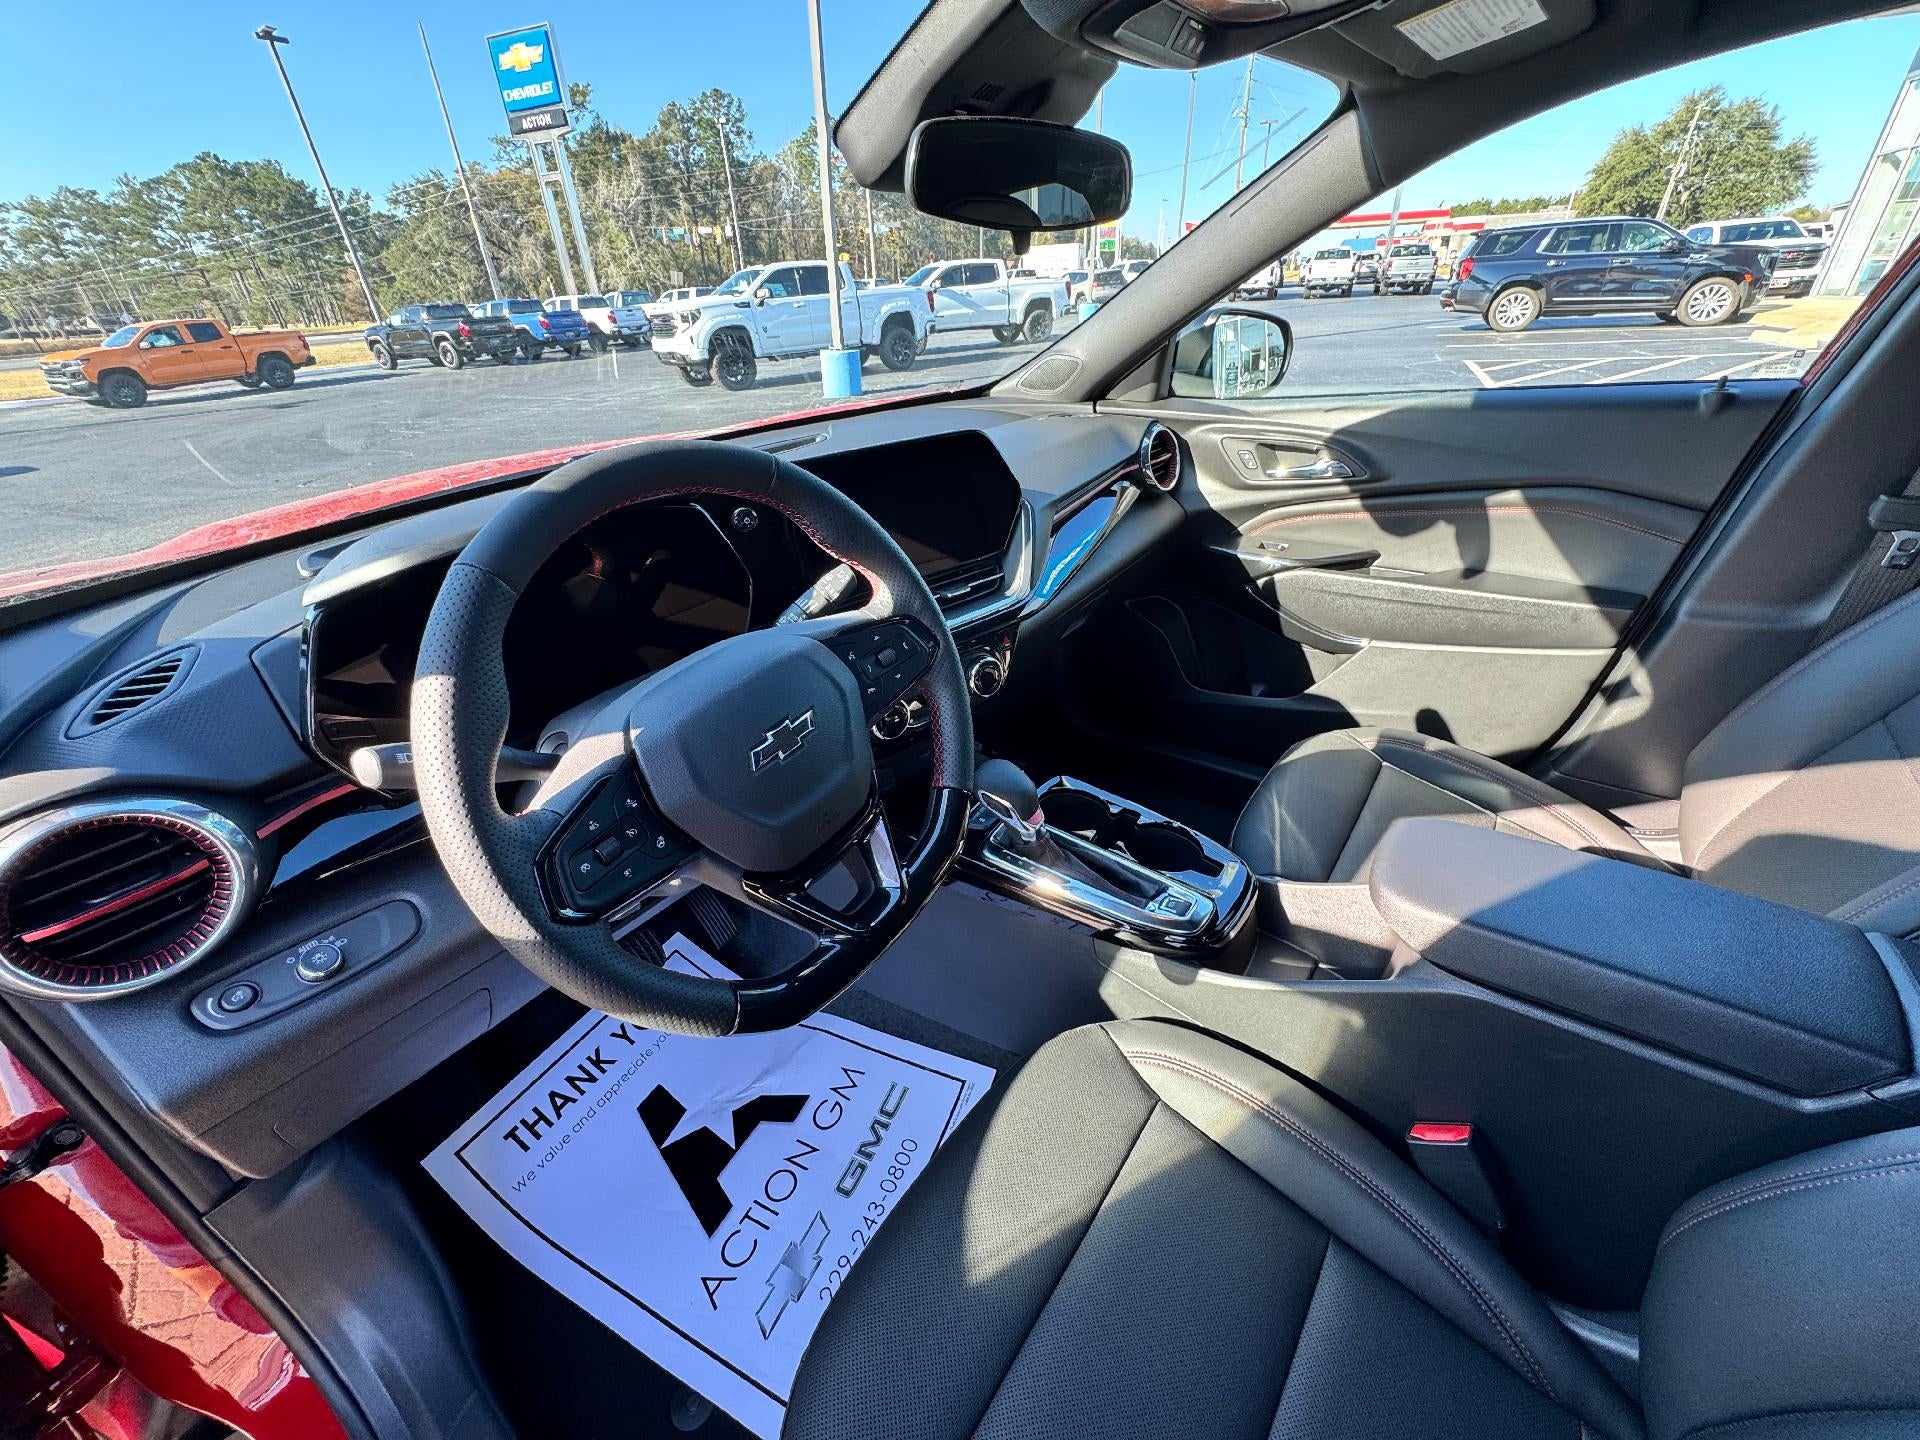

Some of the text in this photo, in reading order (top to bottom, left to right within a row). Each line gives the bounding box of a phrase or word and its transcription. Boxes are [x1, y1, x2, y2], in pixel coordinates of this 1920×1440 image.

[503, 80, 553, 102] CHEVROLET
[522, 113, 552, 130] ACTION
[503, 1045, 619, 1153] THANK
[511, 1169, 537, 1193] We
[537, 1133, 571, 1169] value
[572, 1106, 598, 1134] and
[597, 1048, 654, 1110] appreciate
[834, 1081, 910, 1199] GMC
[700, 1066, 866, 1311] ACTION GM
[819, 1138, 918, 1302] 229-243-0800
